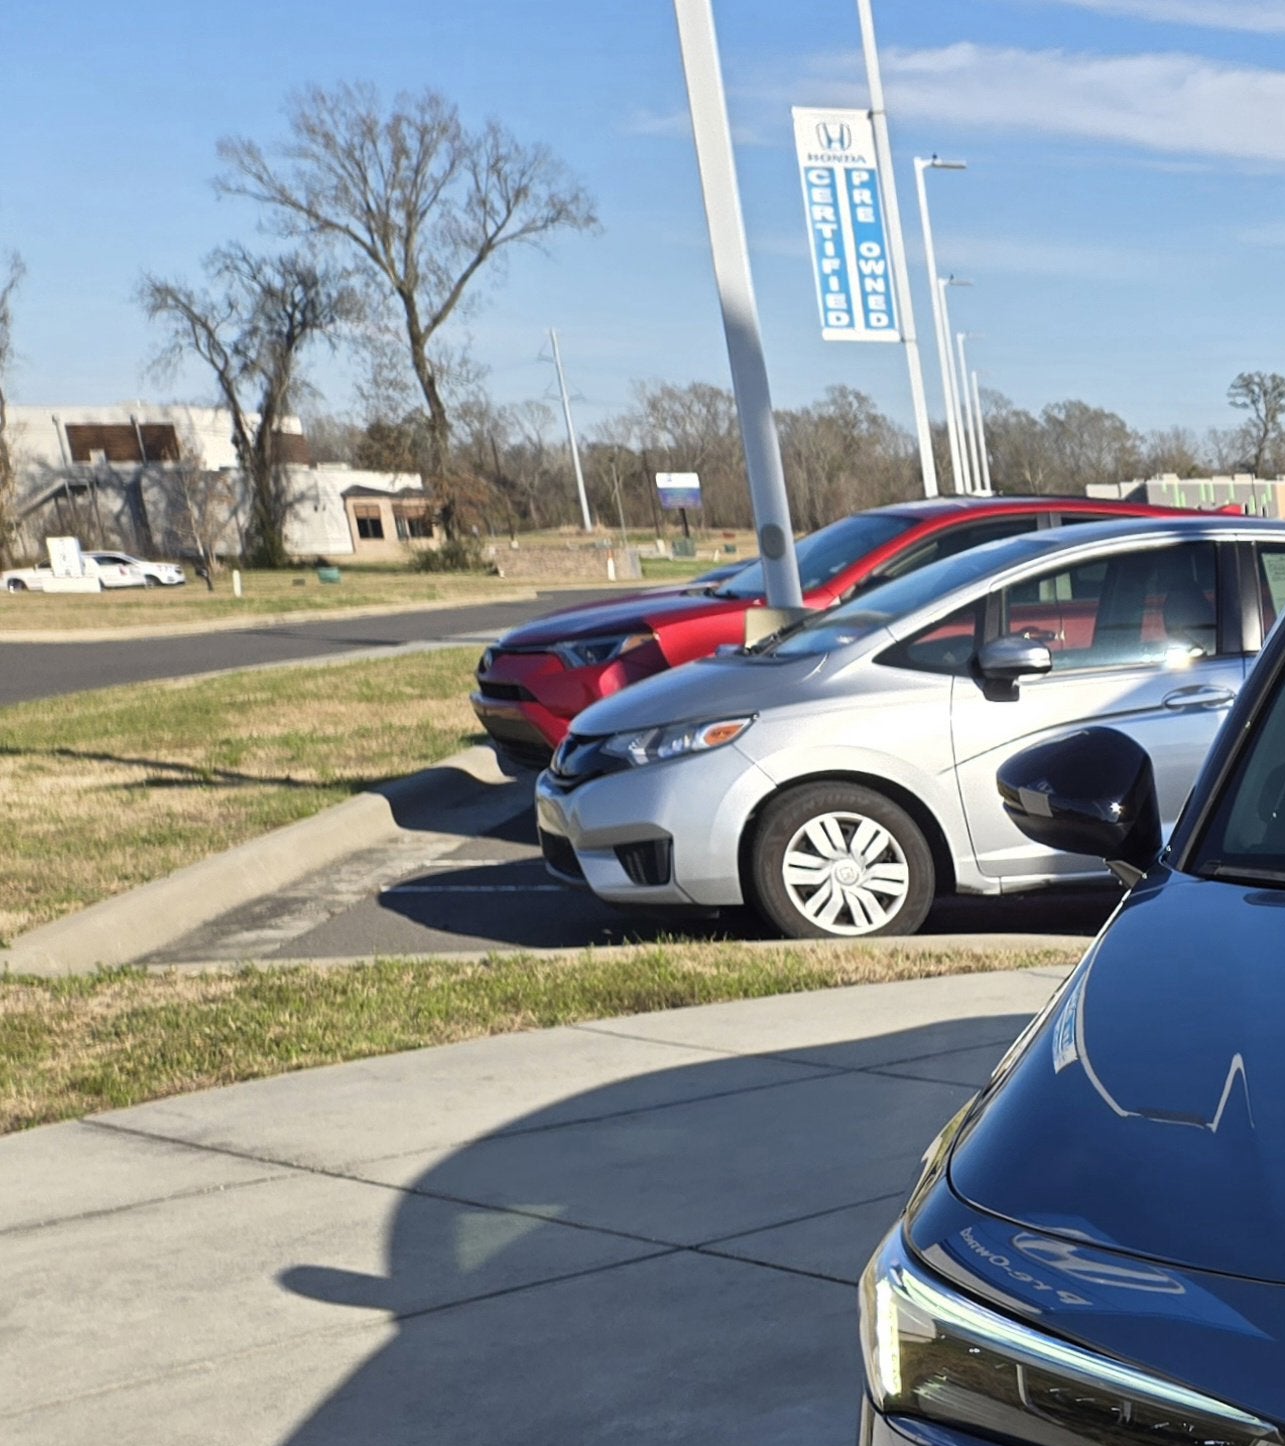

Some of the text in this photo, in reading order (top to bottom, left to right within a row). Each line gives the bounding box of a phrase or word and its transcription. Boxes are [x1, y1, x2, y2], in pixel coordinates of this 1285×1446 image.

[807, 153, 867, 163] HONDA
[807, 169, 850, 327] CERTIFIED
[851, 170, 889, 328] PRE OWNED
